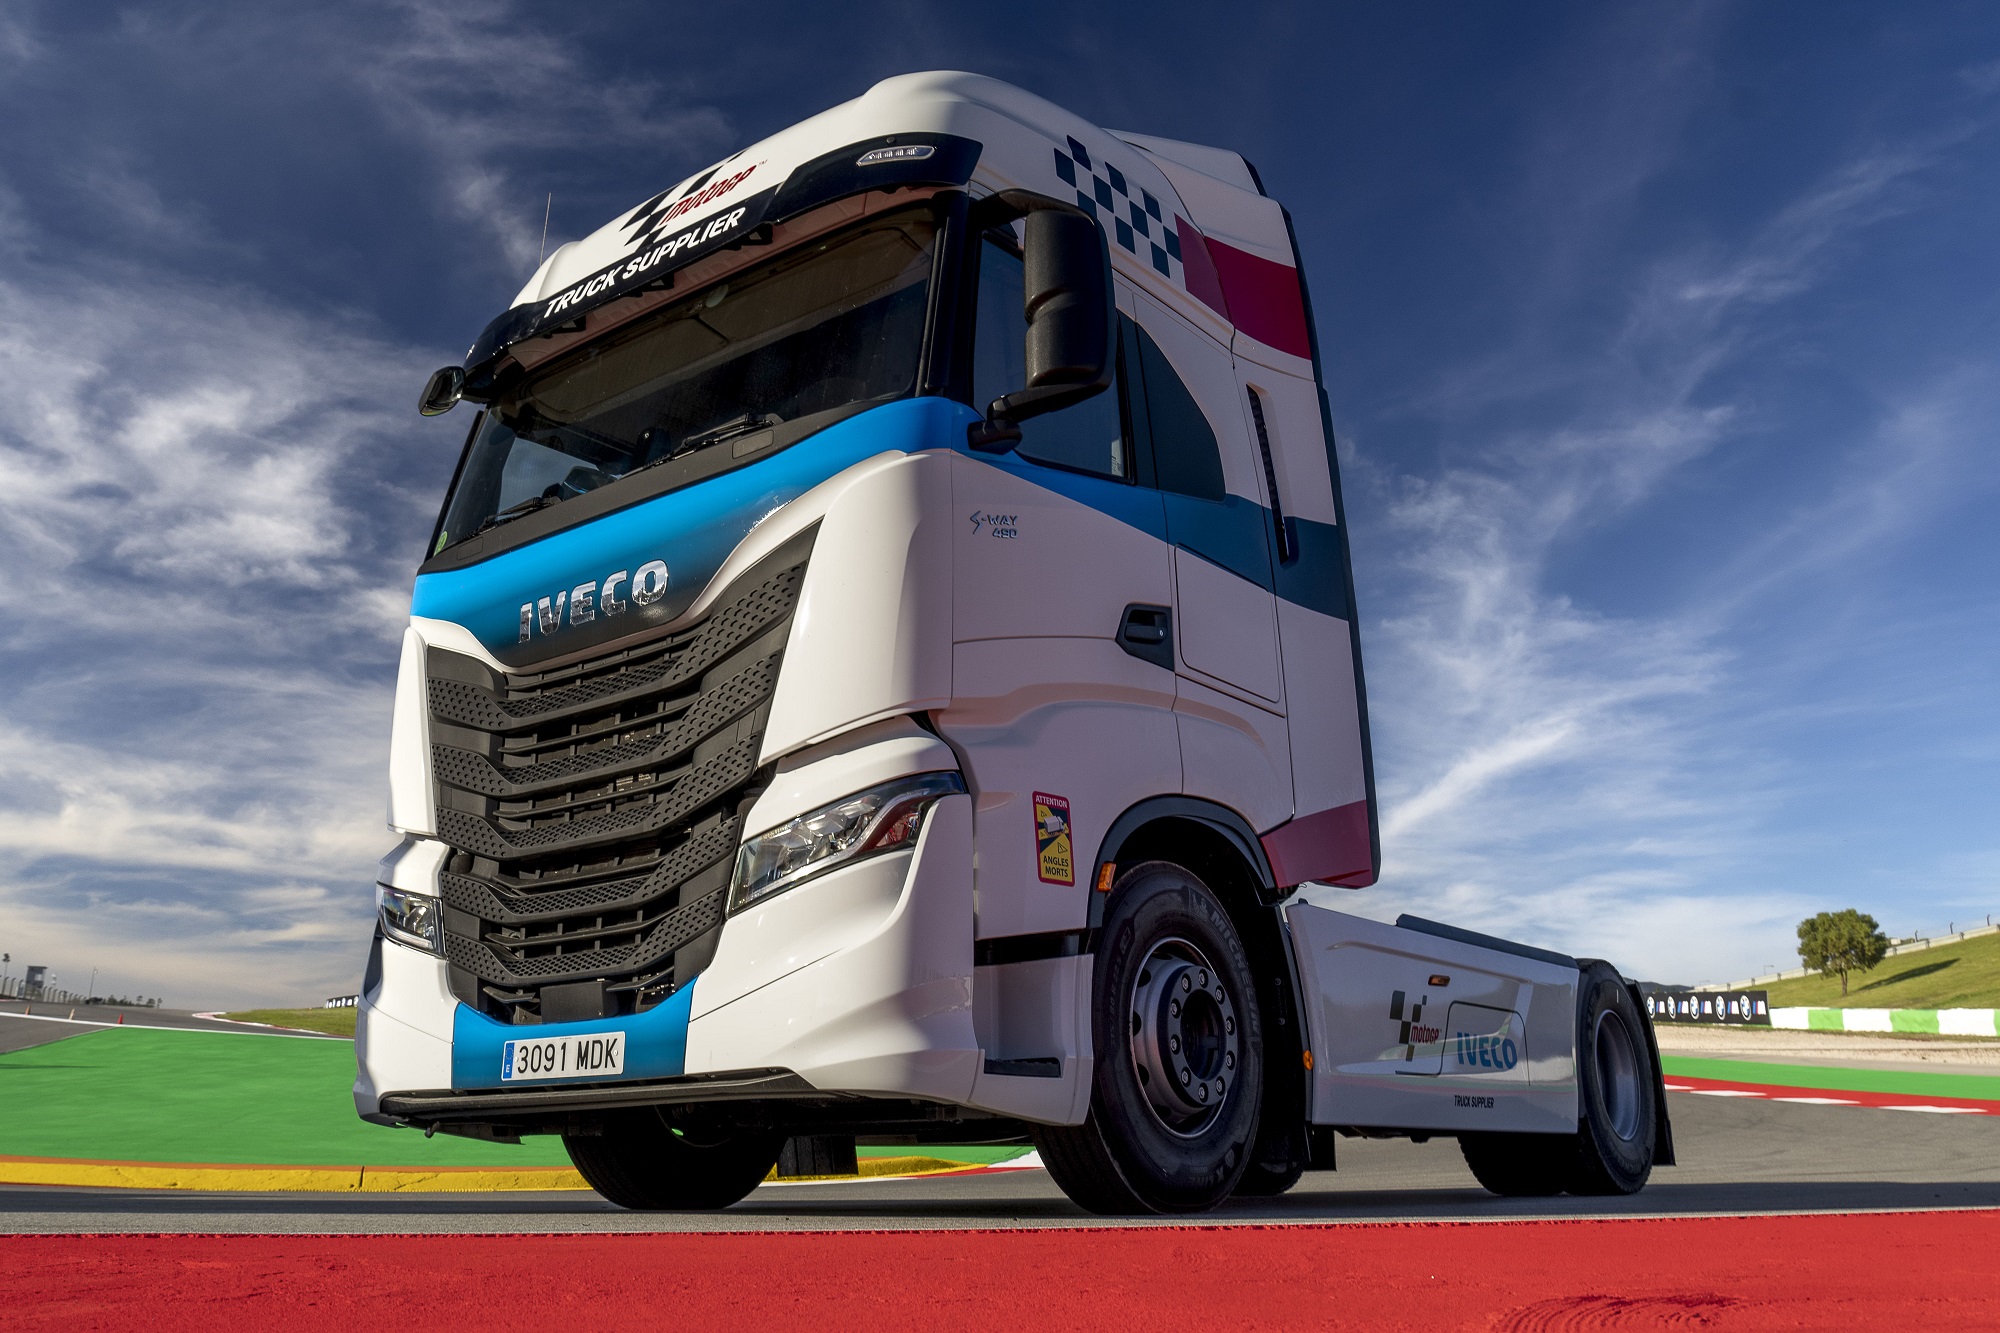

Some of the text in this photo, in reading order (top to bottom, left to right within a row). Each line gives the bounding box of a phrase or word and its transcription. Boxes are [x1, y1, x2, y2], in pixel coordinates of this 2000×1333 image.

[544, 206, 746, 318] TRUCK SUPPLIER
[518, 559, 669, 644] IVECO
[1035, 794, 1068, 809] ATTENTION
[1043, 854, 1069, 867] ANGLES
[1045, 866, 1069, 878] MORTS
[517, 1038, 618, 1074] 3091 MDK
[1457, 1031, 1518, 1070] IVECO
[505, 1064, 511, 1073] E
[1454, 1094, 1495, 1109] TRUCK SUPPLIER
